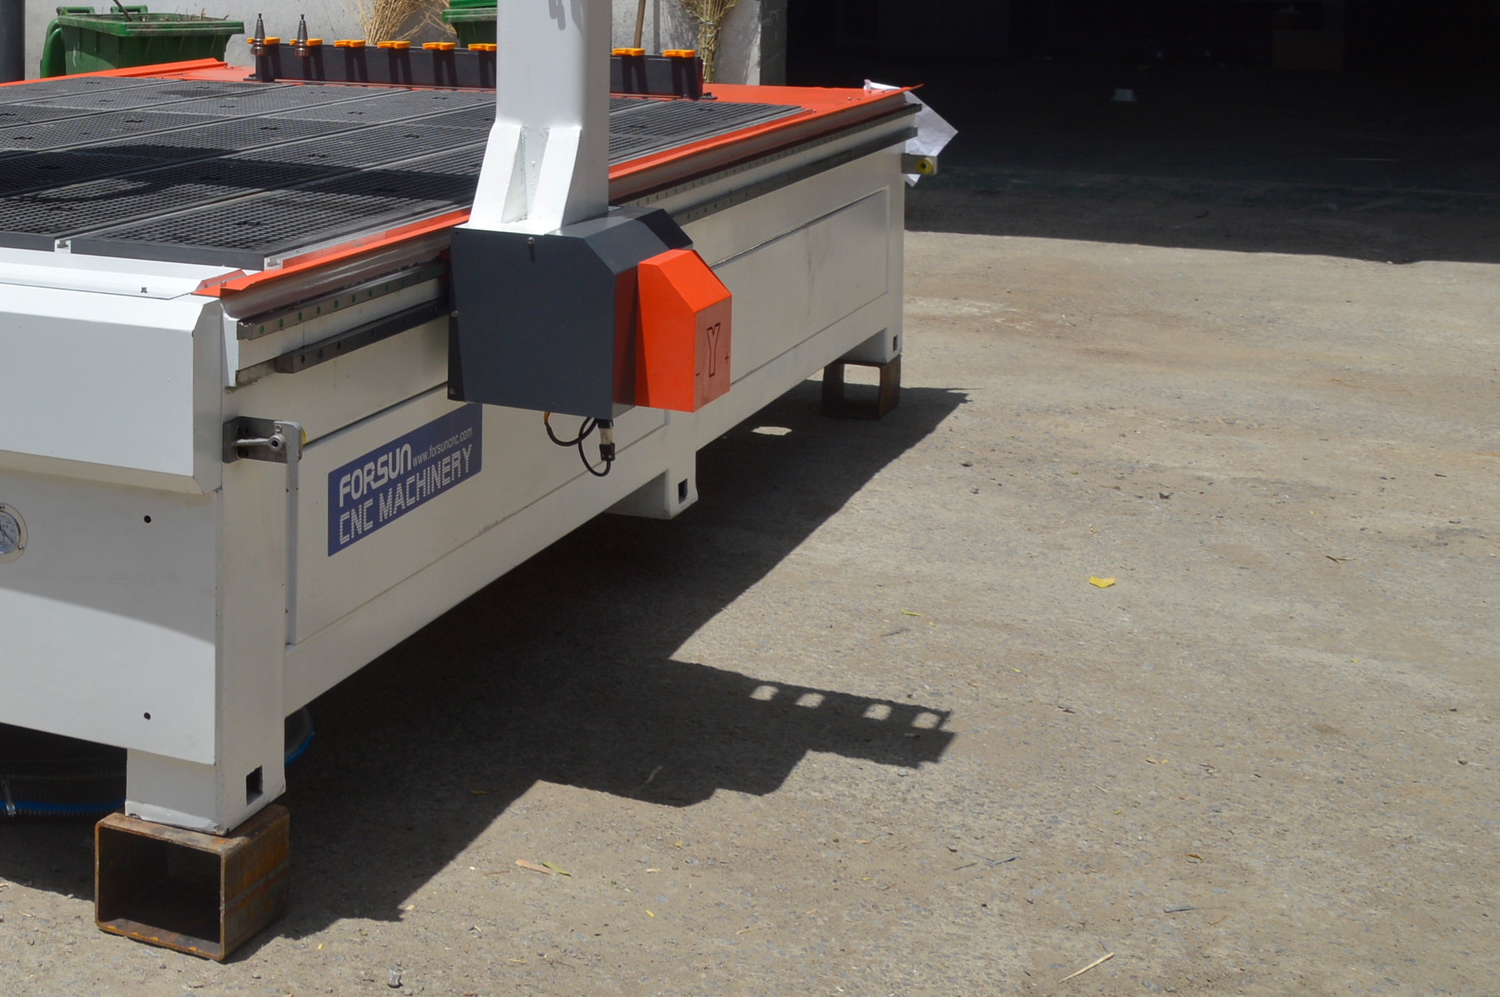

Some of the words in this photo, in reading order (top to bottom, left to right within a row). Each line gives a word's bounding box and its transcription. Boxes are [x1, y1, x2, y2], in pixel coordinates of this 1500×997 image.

[339, 443, 412, 508] FORSUN
[412, 427, 473, 467] www.forsuncnc.com
[339, 498, 374, 545] CNC
[379, 444, 473, 523] MACHINERY
